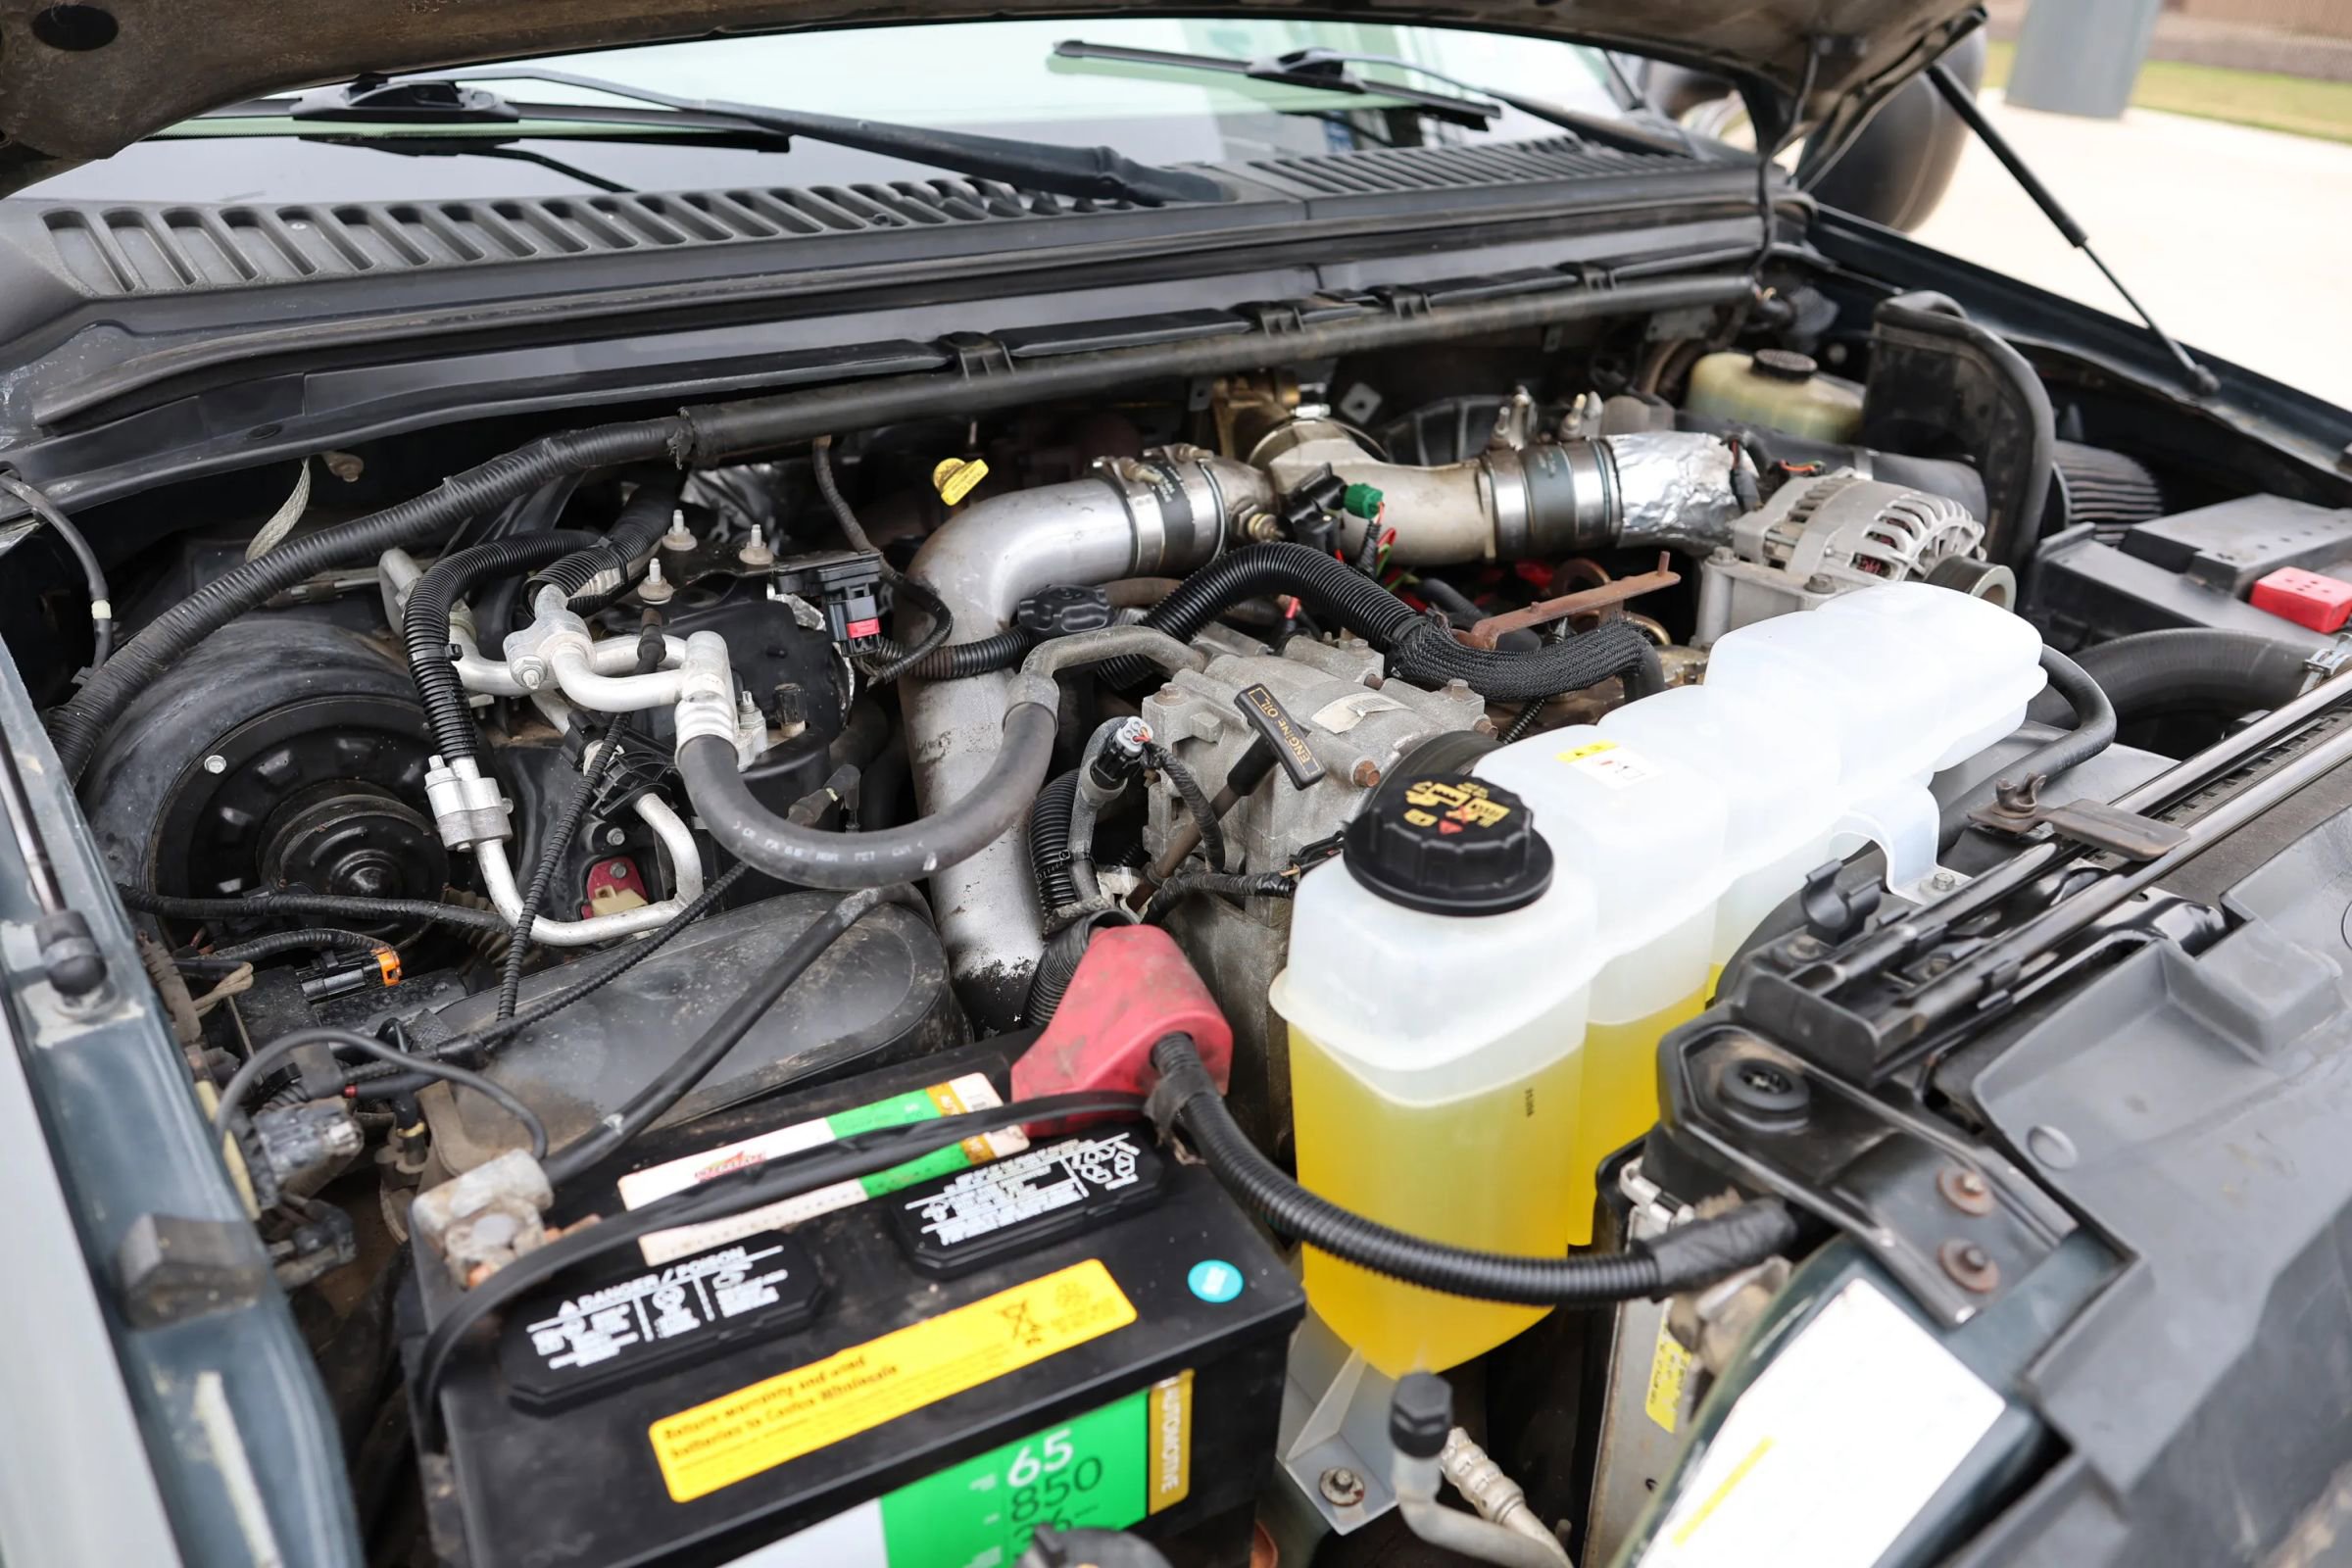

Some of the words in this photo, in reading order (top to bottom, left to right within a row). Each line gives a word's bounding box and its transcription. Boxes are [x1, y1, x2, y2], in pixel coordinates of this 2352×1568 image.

[1261, 697, 1279, 718] OIL
[1278, 718, 1311, 763] ENGINE
[1007, 1428, 1074, 1488] 65
[1160, 1386, 1183, 1494] AUTOMOTIVE
[1010, 1455, 1103, 1523] 850
